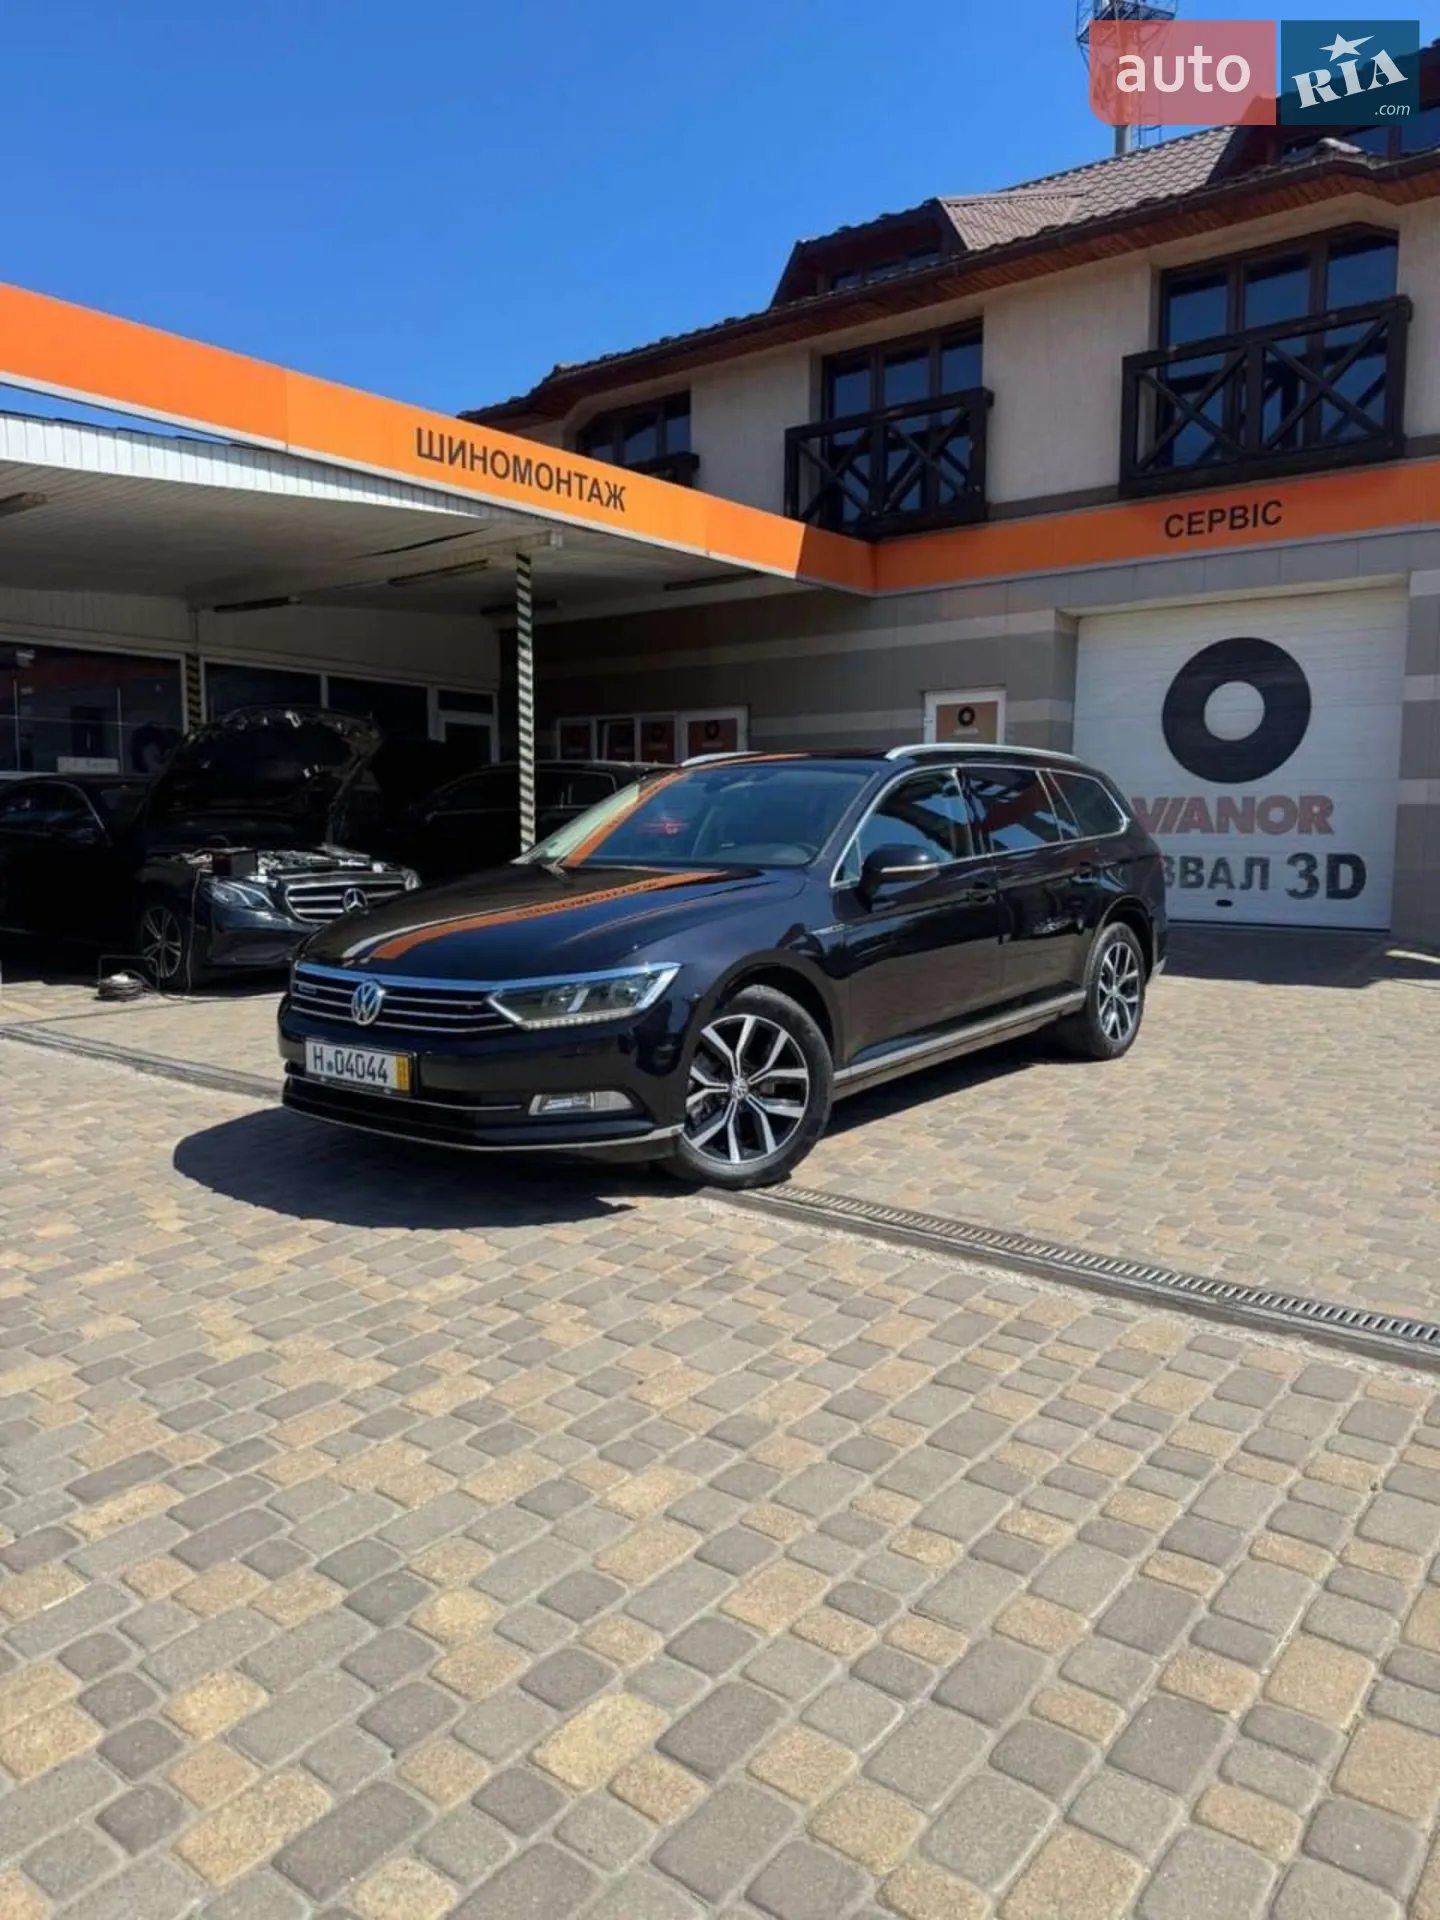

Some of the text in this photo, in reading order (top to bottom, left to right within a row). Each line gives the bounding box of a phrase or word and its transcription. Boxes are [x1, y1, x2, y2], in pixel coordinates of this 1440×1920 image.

[416, 427, 626, 512] ШИНОМОНТАЖ
[1164, 500, 1283, 539] СЕРВІС
[1130, 795, 1335, 835] VIANOR
[1285, 852, 1367, 900] 3D
